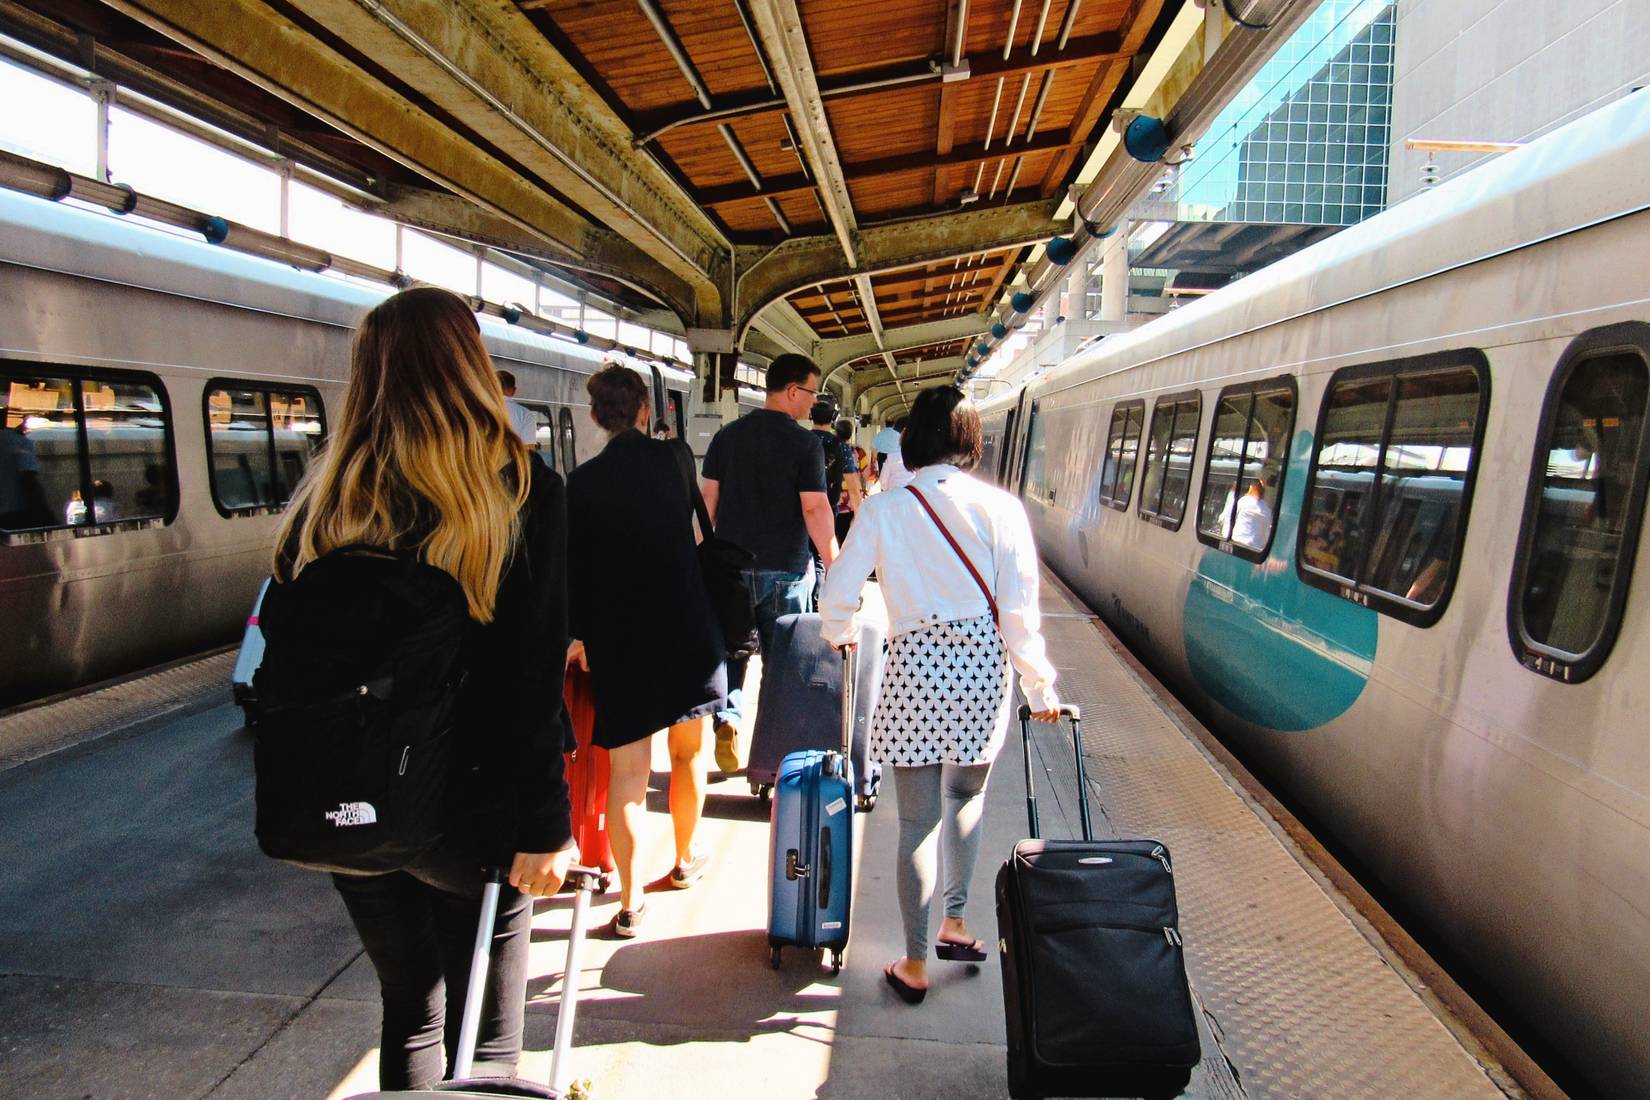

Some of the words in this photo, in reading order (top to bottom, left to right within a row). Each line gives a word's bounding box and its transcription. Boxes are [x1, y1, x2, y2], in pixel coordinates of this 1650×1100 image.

[339, 802, 359, 811] THE
[325, 811, 359, 820] NORTH
[335, 818, 360, 827] FACE
